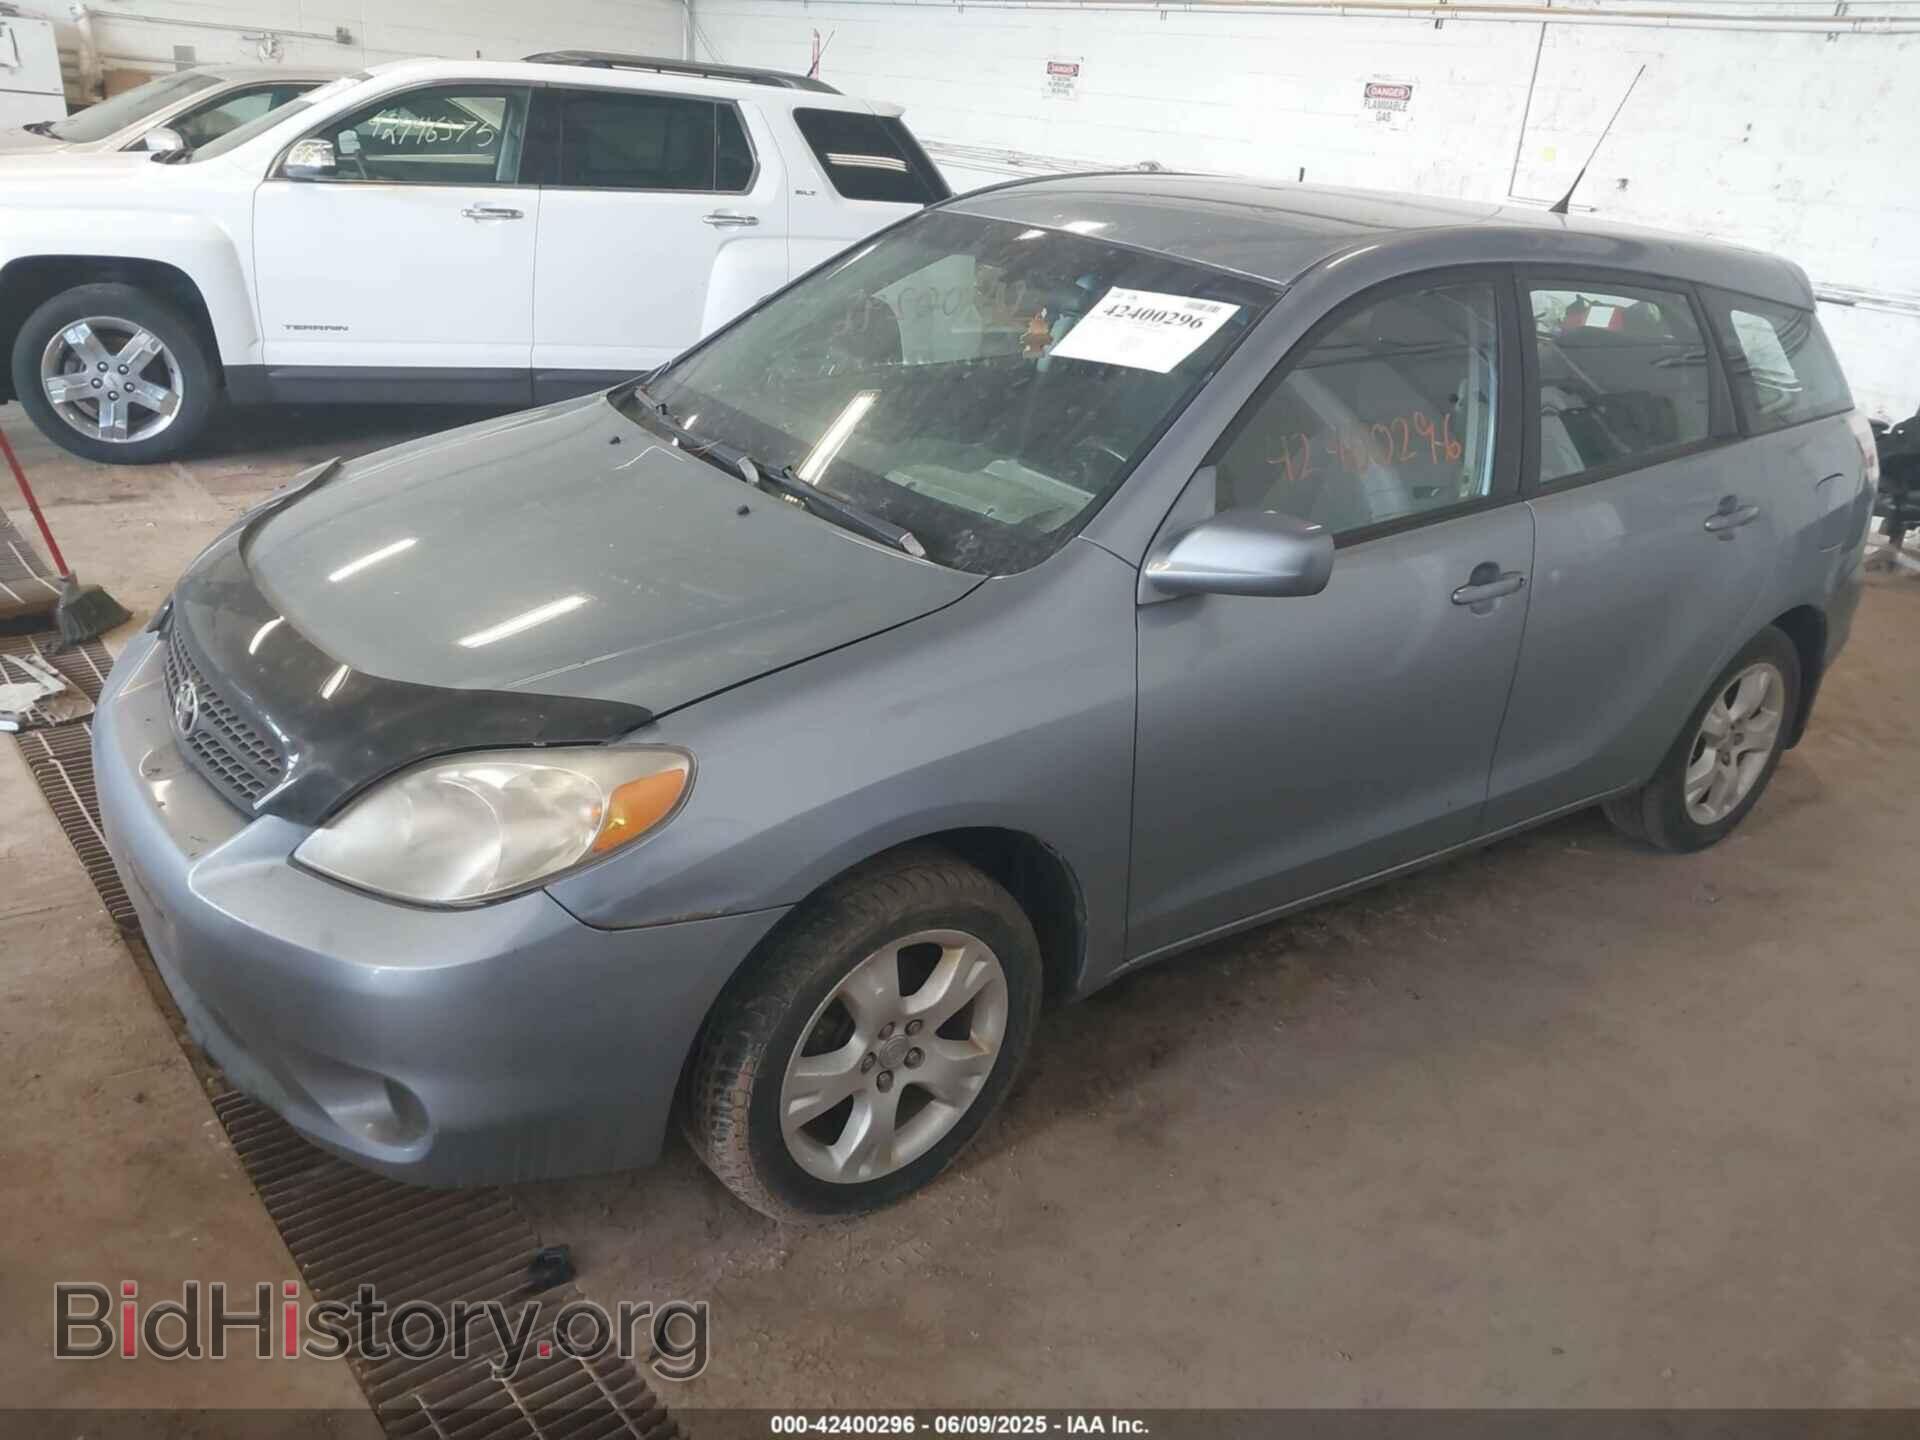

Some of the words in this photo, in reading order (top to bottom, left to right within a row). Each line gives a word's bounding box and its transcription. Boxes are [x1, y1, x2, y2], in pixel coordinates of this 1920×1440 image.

[1370, 87, 1406, 98] DANGER
[1364, 99, 1408, 112] FLAMMABLE
[1375, 111, 1391, 122] GAS
[1103, 303, 1204, 330] 42400296
[284, 324, 349, 332] TERRAIN
